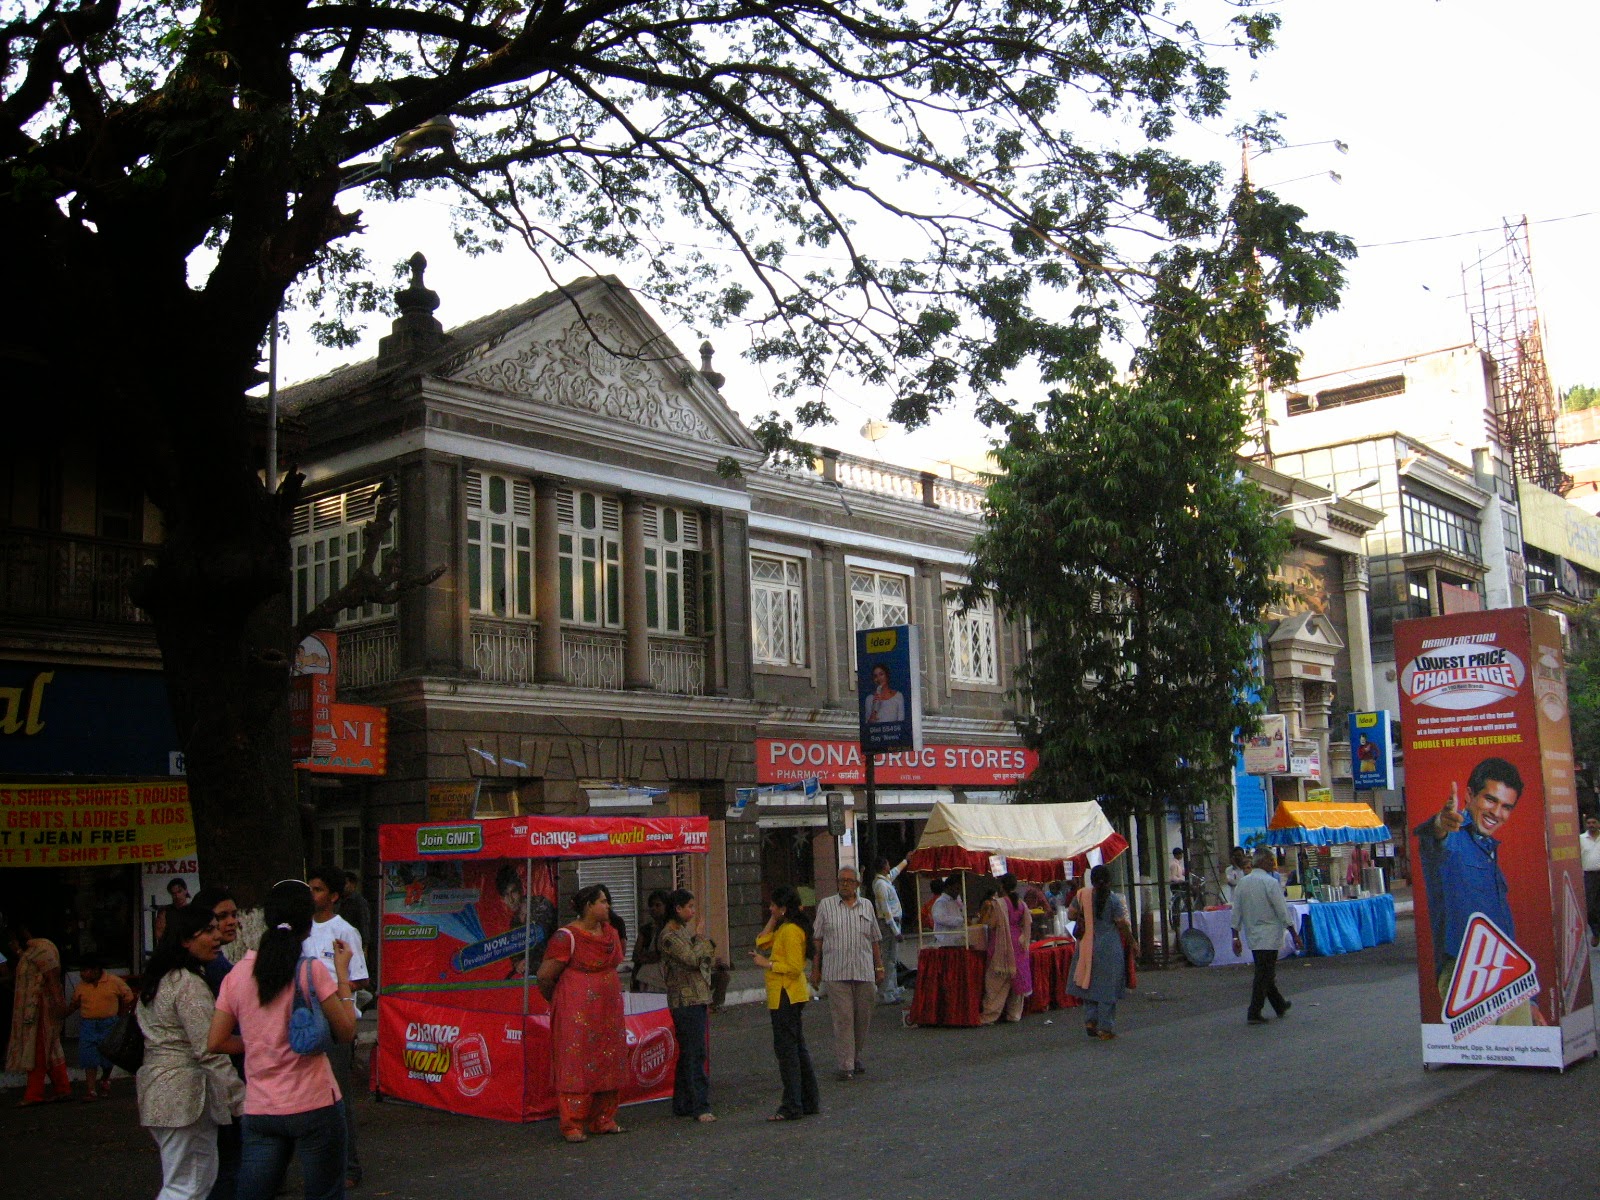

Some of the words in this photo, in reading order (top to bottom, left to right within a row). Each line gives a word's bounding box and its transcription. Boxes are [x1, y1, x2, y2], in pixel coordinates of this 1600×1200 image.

[1422, 638, 1452, 649] BRAND
[1453, 632, 1496, 645] FACTORY
[1415, 656, 1465, 672] LOWEST
[1469, 647, 1507, 667] PRICE
[1412, 666, 1516, 695] CHALLENGE
[1456, 714, 1479, 722] product
[1428, 727, 1443, 735] lower
[1413, 739, 1440, 749] DOUBLE
[1441, 738, 1455, 748] THE
[1456, 737, 1478, 746] PRICE
[770, 742, 862, 766] POONA
[944, 748, 1025, 769] STORES
[777, 770, 828, 780] PHARMACY
[72, 810, 129, 828] LADIES
[136, 809, 147, 826] &
[34, 831, 83, 846] JEAN
[91, 829, 137, 844] FREE
[421, 834, 443, 847] Join
[445, 831, 476, 845] GNIIT
[530, 831, 577, 849] Change
[609, 826, 646, 845] world
[646, 833, 661, 841] sees
[661, 833, 674, 842] you
[118, 843, 165, 859] FREE
[147, 860, 199, 875] TEXAS
[386, 928, 405, 937] Join
[407, 926, 434, 936] GNIIT
[463, 952, 493, 967] Developer
[1450, 1005, 1486, 1035] BRAND
[1486, 973, 1537, 1013] FACTORY
[1467, 1015, 1493, 1033] BRANDS
[1496, 1001, 1517, 1016] SMART
[1517, 986, 1538, 1004] PRICES
[406, 1022, 460, 1044] Change
[1515, 1046, 1529, 1054] High
[425, 1073, 443, 1084] you
